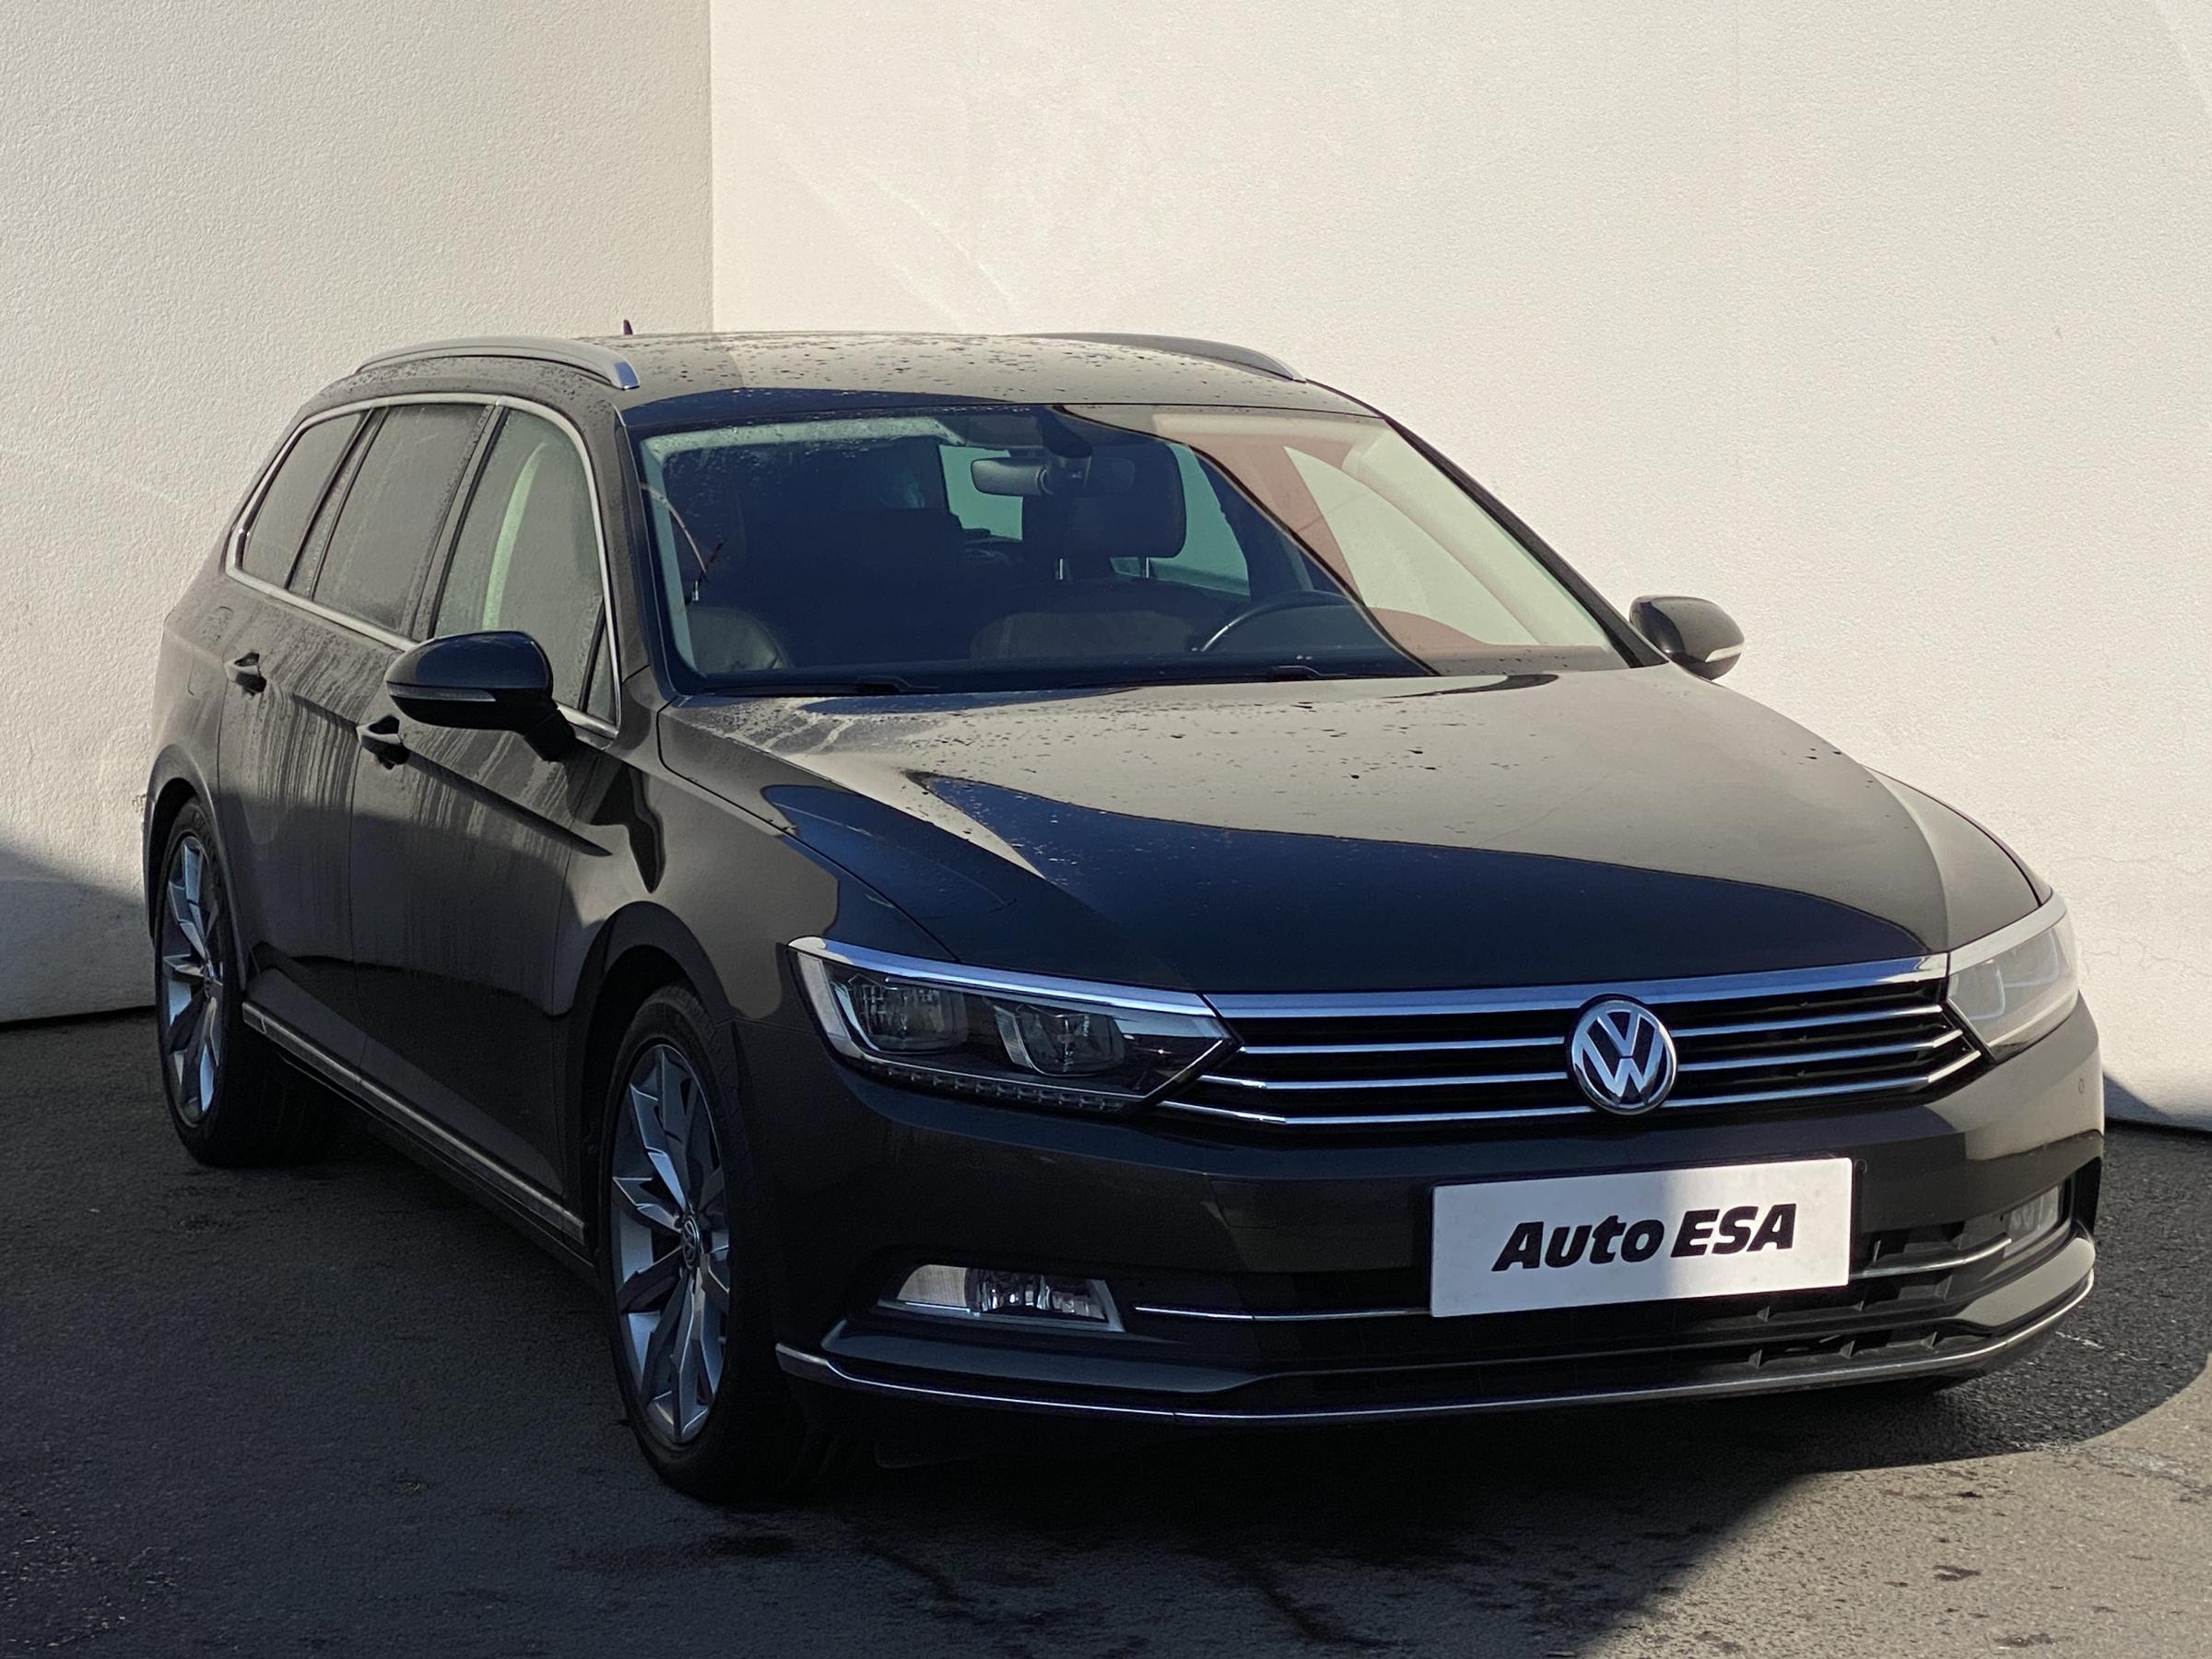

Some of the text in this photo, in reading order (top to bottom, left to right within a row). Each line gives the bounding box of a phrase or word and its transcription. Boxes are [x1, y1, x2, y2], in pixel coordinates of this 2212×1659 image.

[1576, 1006, 1669, 1109] VW
[1491, 1204, 1796, 1273] Auto ESA
